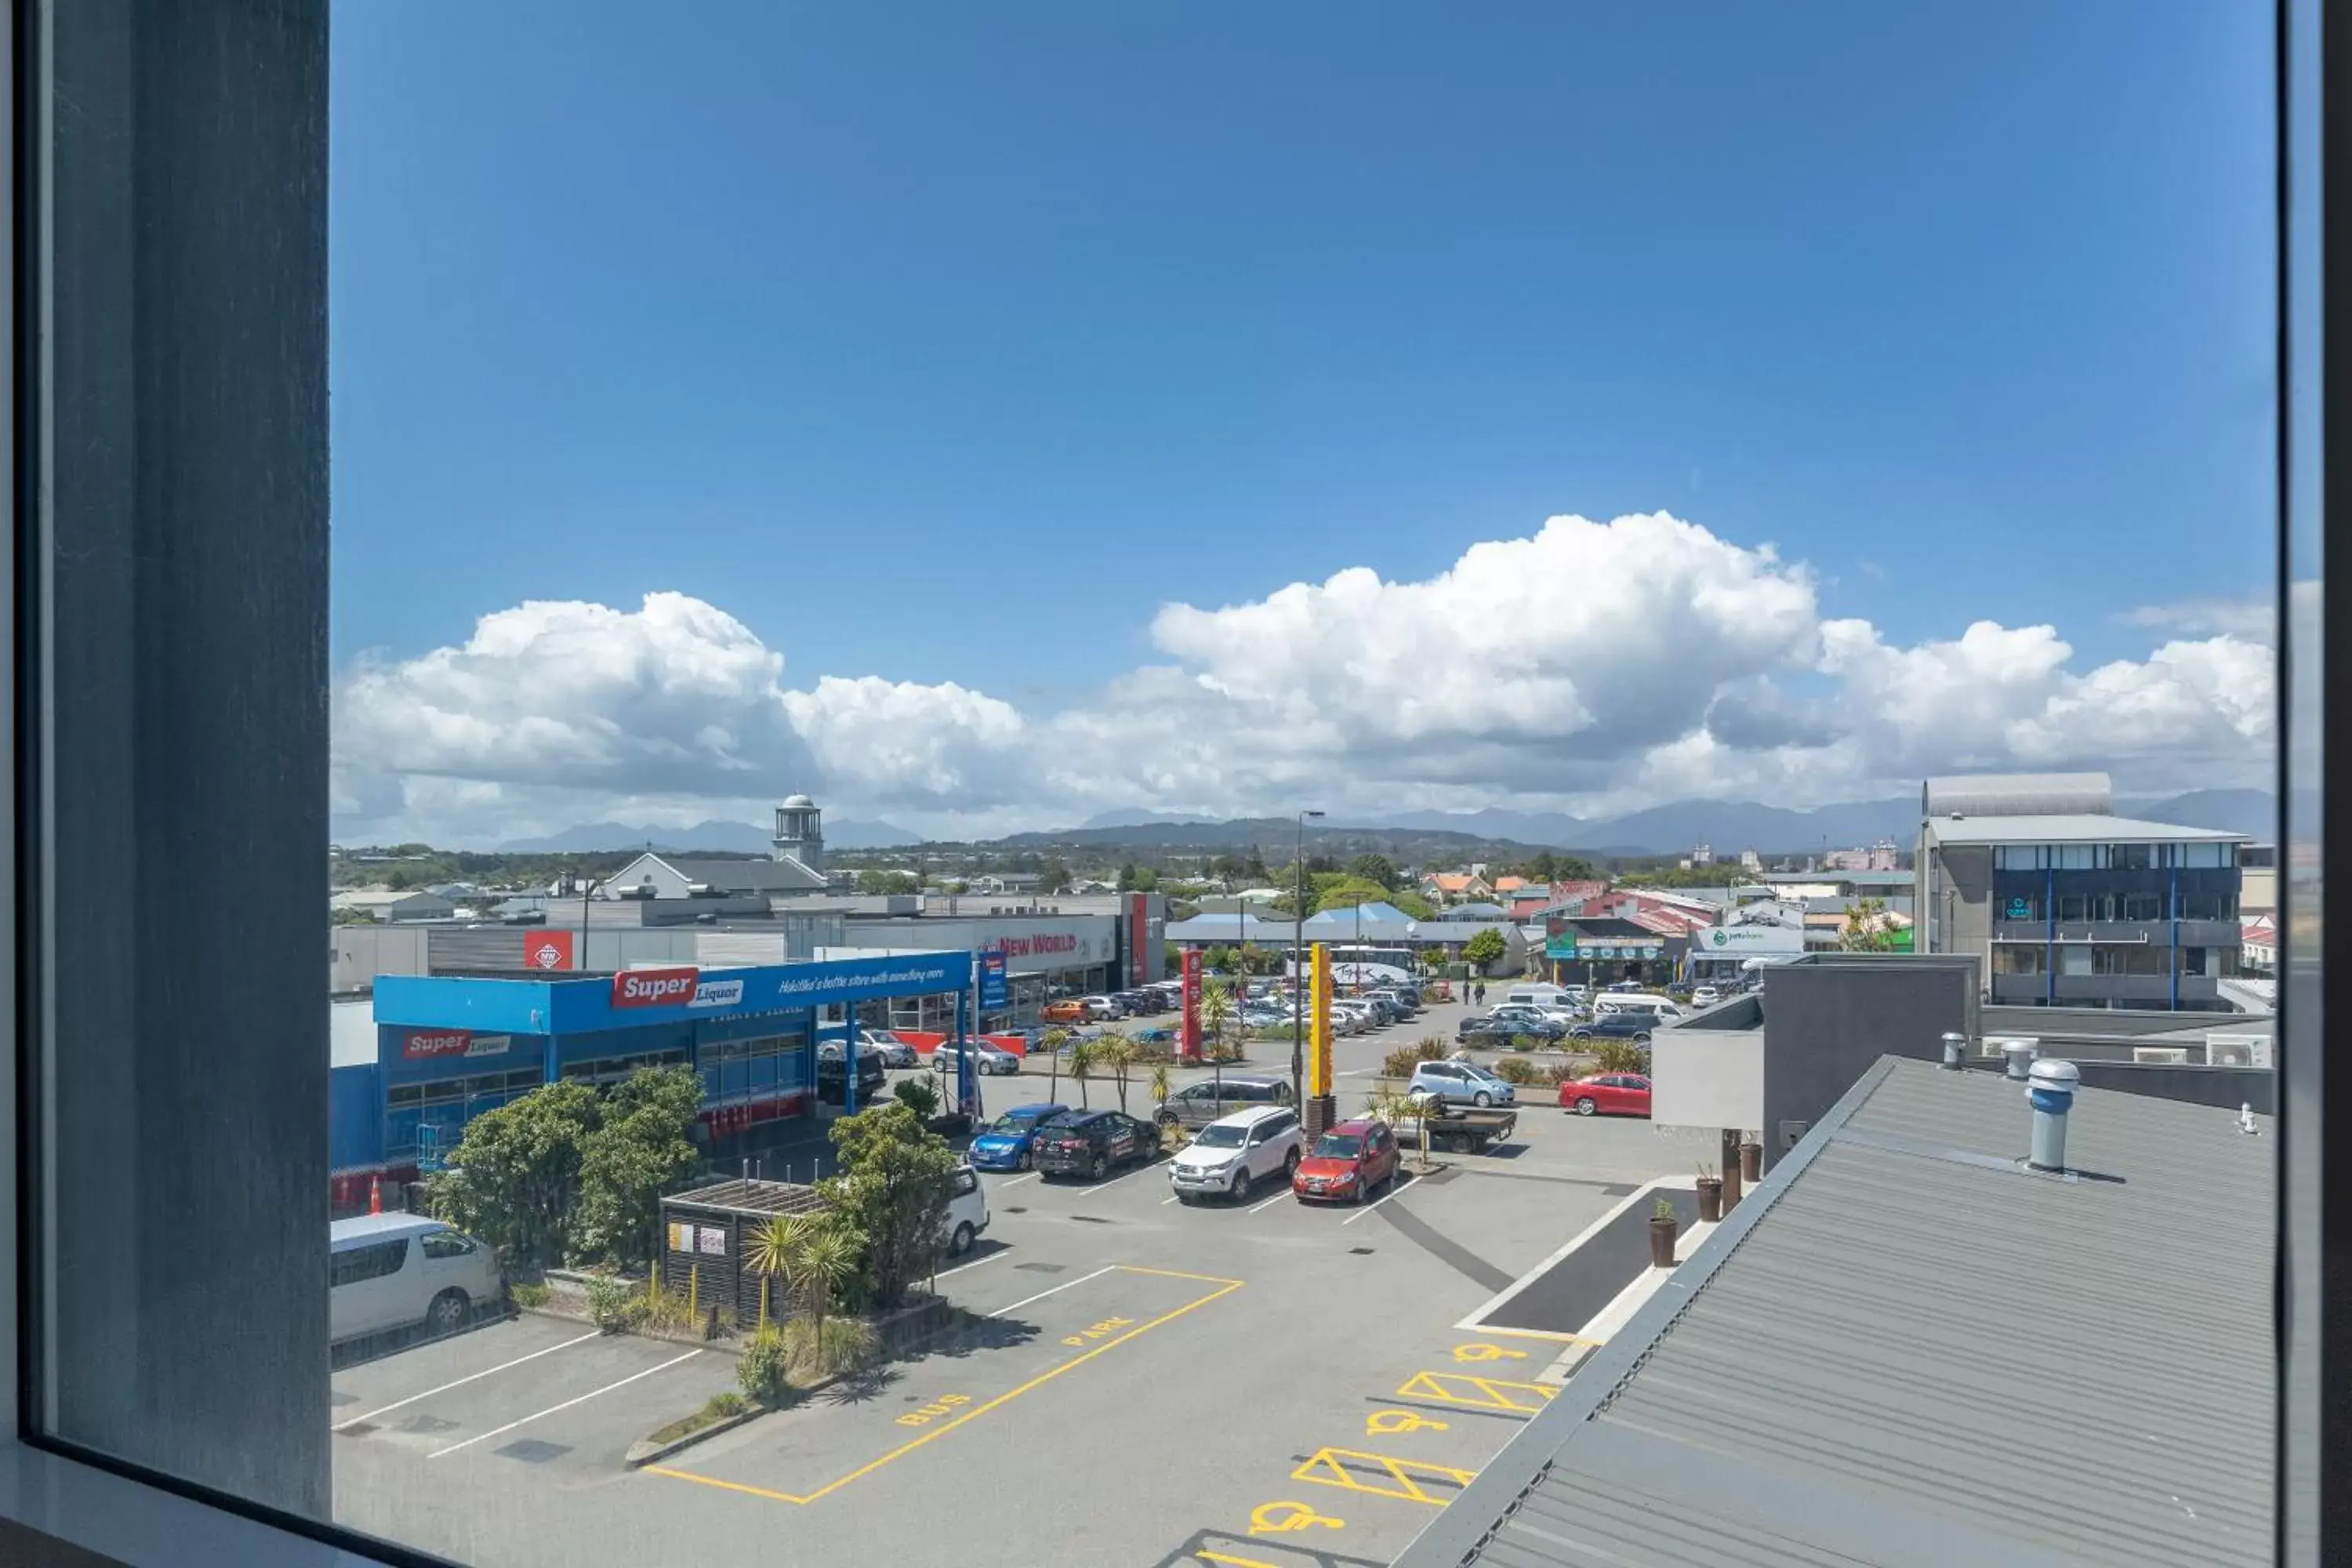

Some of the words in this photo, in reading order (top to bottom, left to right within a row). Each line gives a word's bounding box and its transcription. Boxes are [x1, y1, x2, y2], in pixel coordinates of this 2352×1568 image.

[1000, 937, 1030, 957] NEW
[1032, 933, 1077, 954] WORLD
[624, 977, 691, 1001] Super
[848, 974, 869, 987] store
[695, 986, 739, 1003] Liquor
[409, 1035, 465, 1053] Super
[895, 1394, 971, 1426] BUS
[1062, 1316, 1134, 1347] PARK
